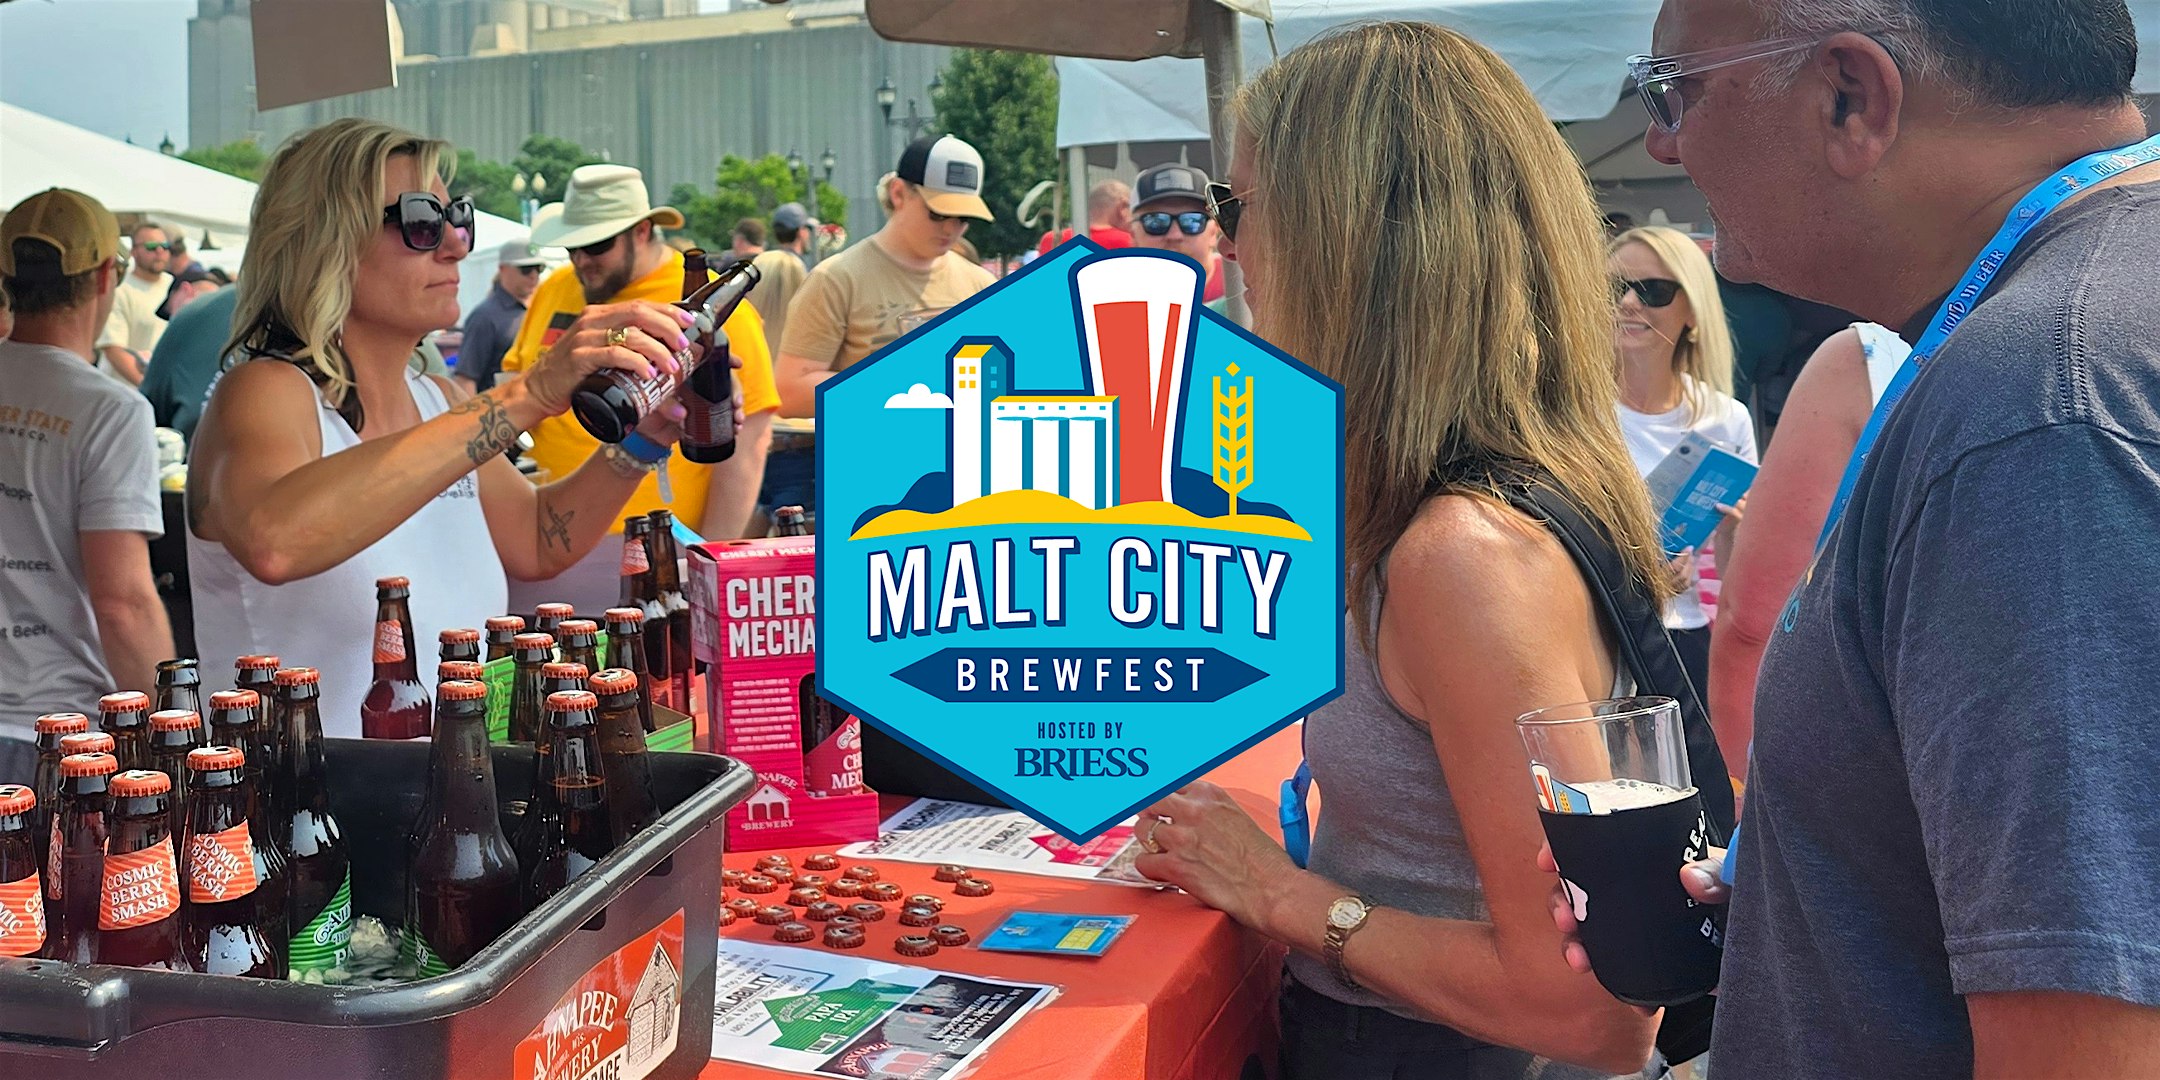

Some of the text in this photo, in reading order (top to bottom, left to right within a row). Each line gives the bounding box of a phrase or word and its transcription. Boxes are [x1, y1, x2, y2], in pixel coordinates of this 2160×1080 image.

[191, 844, 235, 884] BERRY
[197, 834, 244, 875] COSMIC
[106, 860, 164, 890] COSMIC
[111, 877, 163, 906] BERRY
[112, 893, 169, 923] SMASH
[804, 1003, 843, 1022] PAPA
[829, 1009, 860, 1023] IPA
[533, 990, 618, 1080] AHNAPEE
